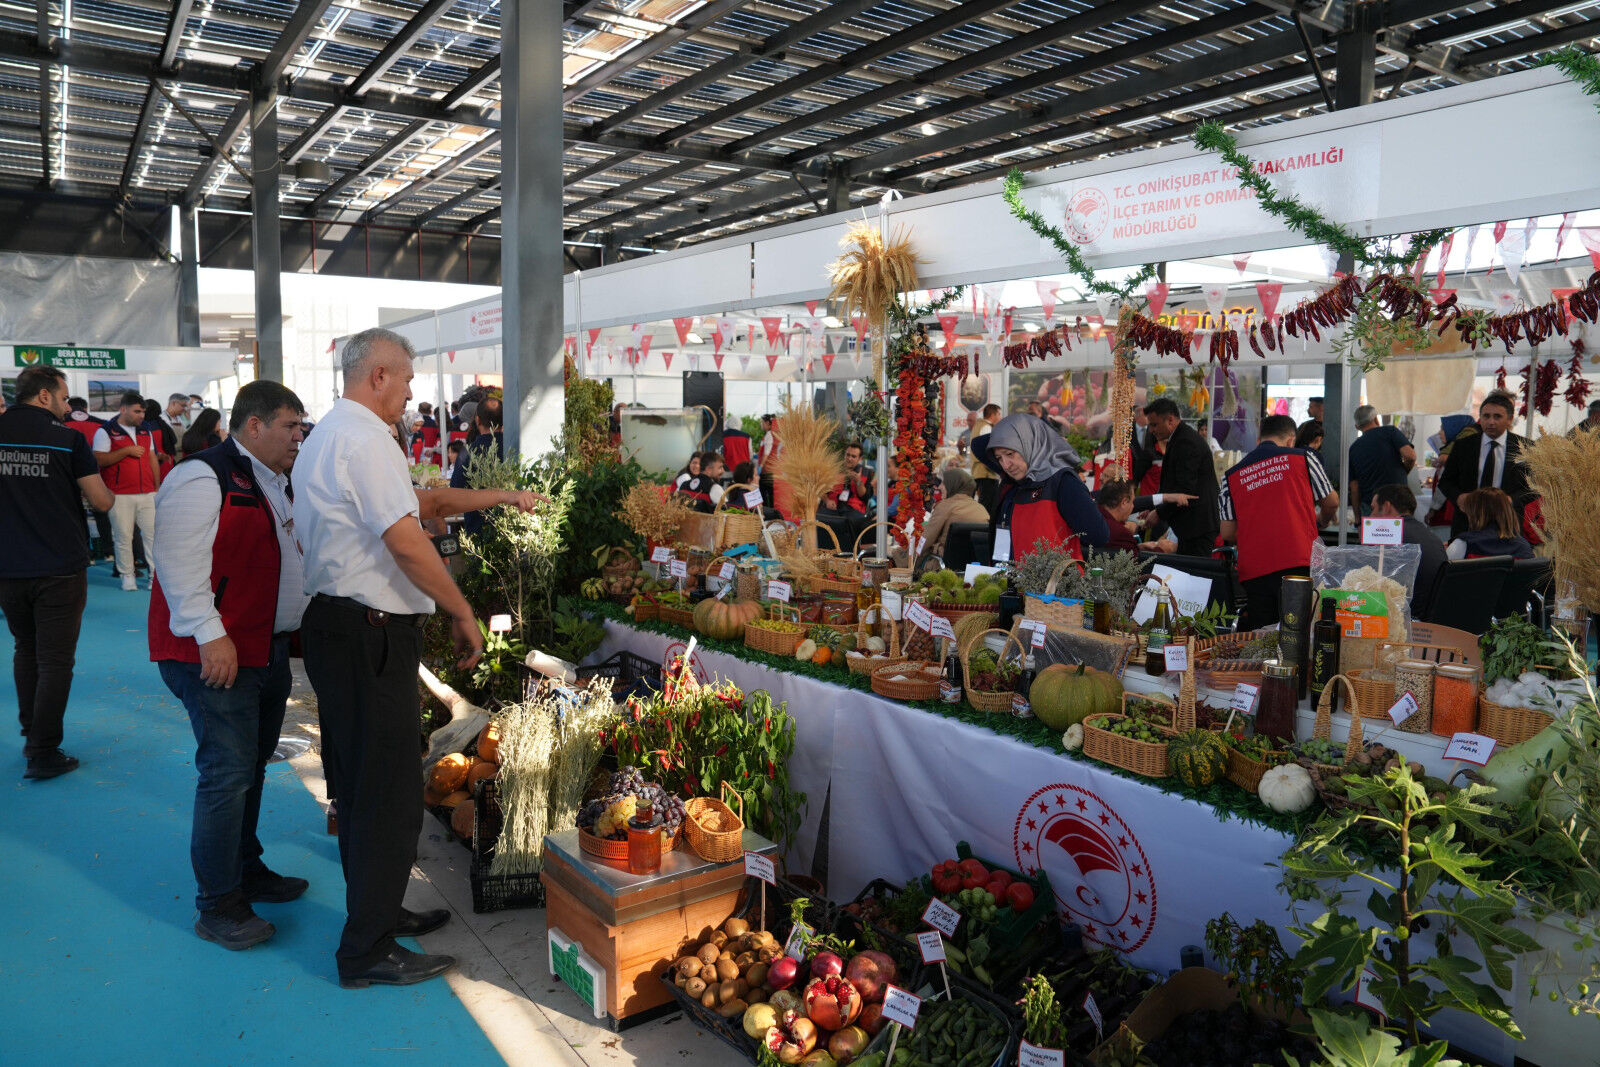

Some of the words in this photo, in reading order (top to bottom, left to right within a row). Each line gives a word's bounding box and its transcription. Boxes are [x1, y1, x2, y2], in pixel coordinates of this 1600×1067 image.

[1114, 185, 1135, 199] T.C.
[1137, 169, 1219, 195] ONİKİŞUBAT
[1221, 146, 1344, 182] KAMAKAMLIĞI
[1113, 203, 1139, 220] İLÇE
[1141, 197, 1181, 215] TARIM
[1184, 194, 1201, 208] VE
[1113, 213, 1197, 239] MÜDÜRLÜĞÜ
[65, 358, 74, 366] VE
[89, 350, 111, 359] METAL
[0, 449, 50, 465] ÜRÜNLERİ
[1273, 455, 1289, 464] İLÇE
[0, 463, 49, 478] NTROL
[1240, 473, 1258, 485] TARIM
[1258, 469, 1266, 477] VE
[1266, 464, 1290, 474] ORMAN
[1246, 473, 1284, 491] MÜDÜRLÜĞÜ
